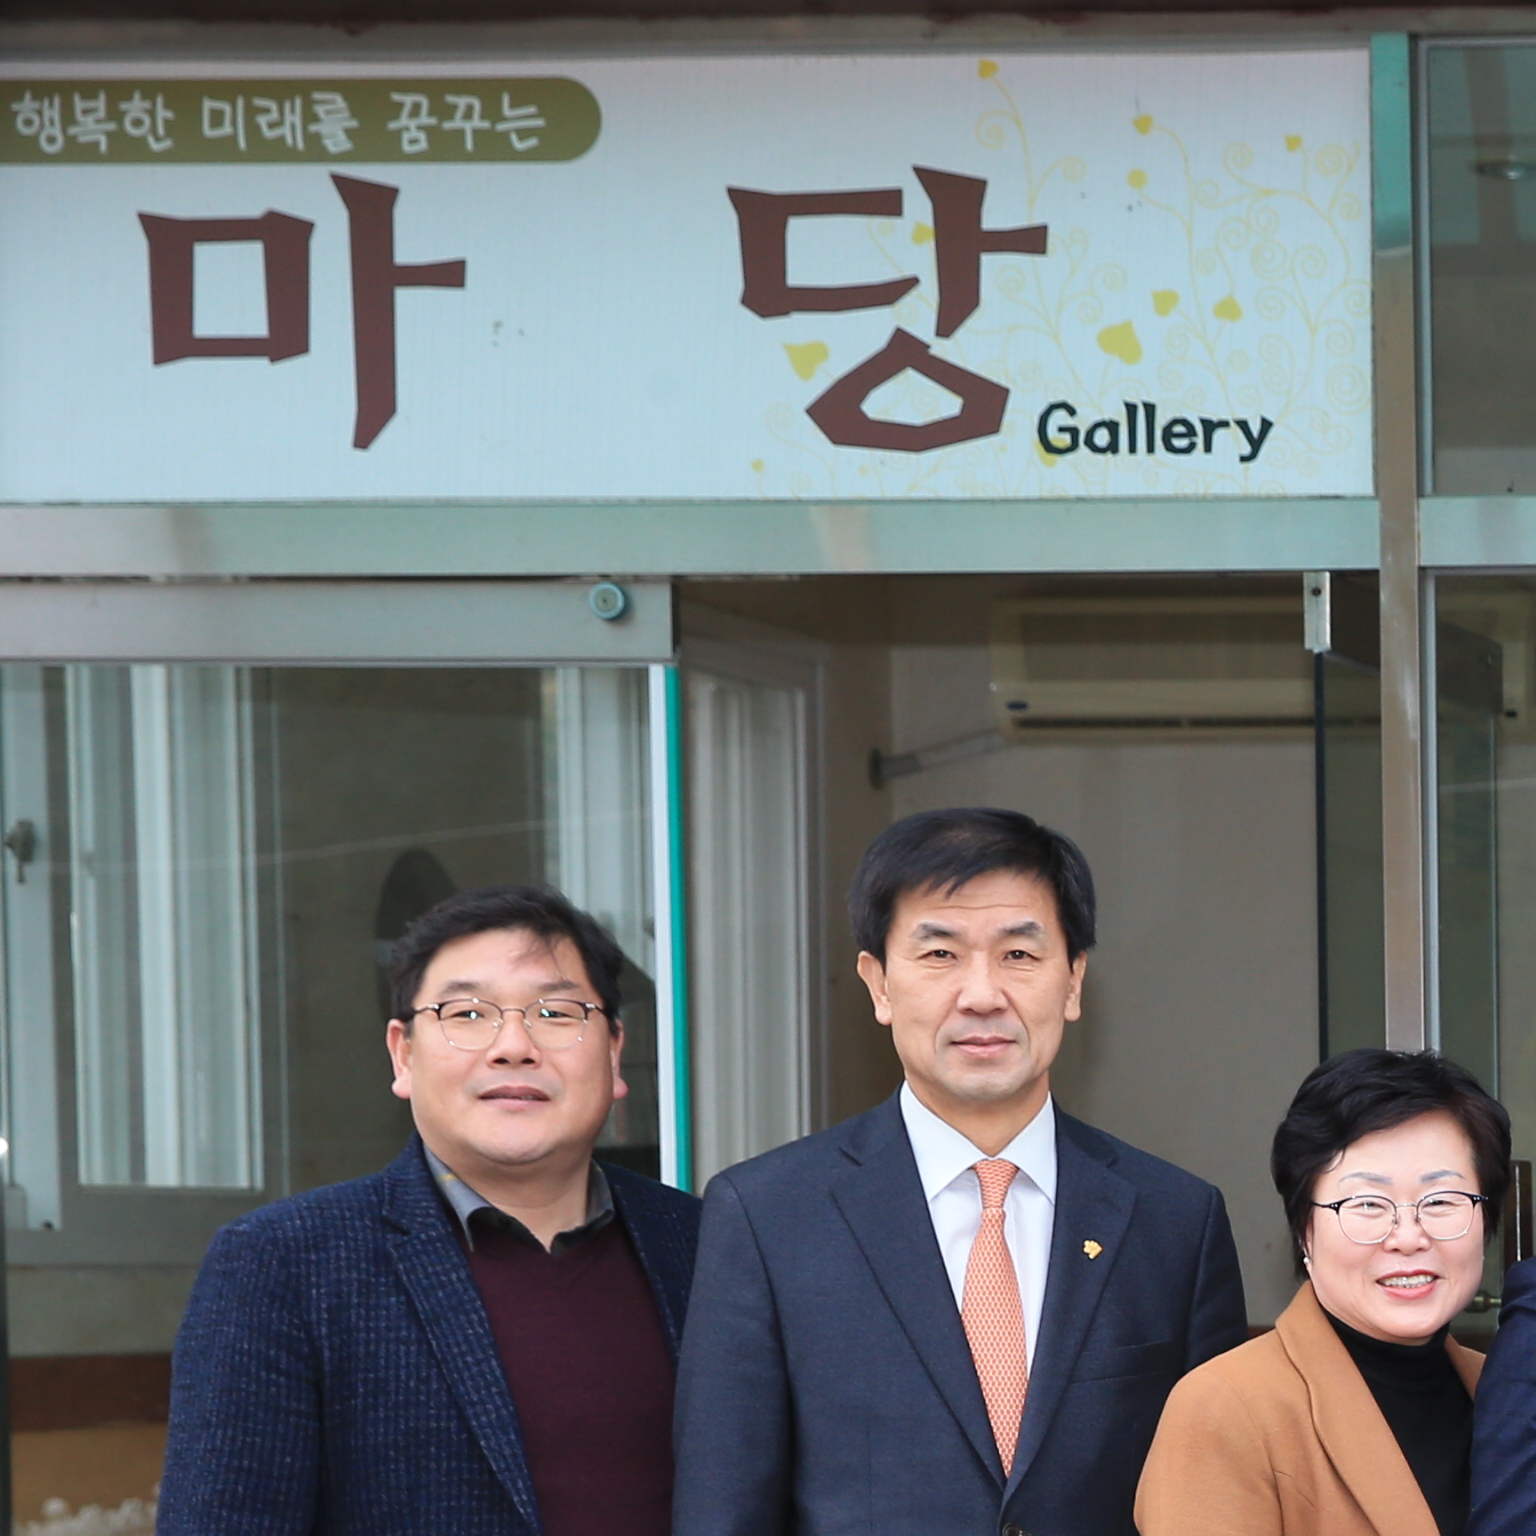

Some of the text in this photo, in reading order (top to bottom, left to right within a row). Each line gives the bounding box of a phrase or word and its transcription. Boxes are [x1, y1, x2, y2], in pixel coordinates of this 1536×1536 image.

[14, 91, 546, 155] 행복한 미래를 꿈꾸는
[138, 165, 1048, 452] 마 당
[1038, 400, 1274, 462] Gallery
